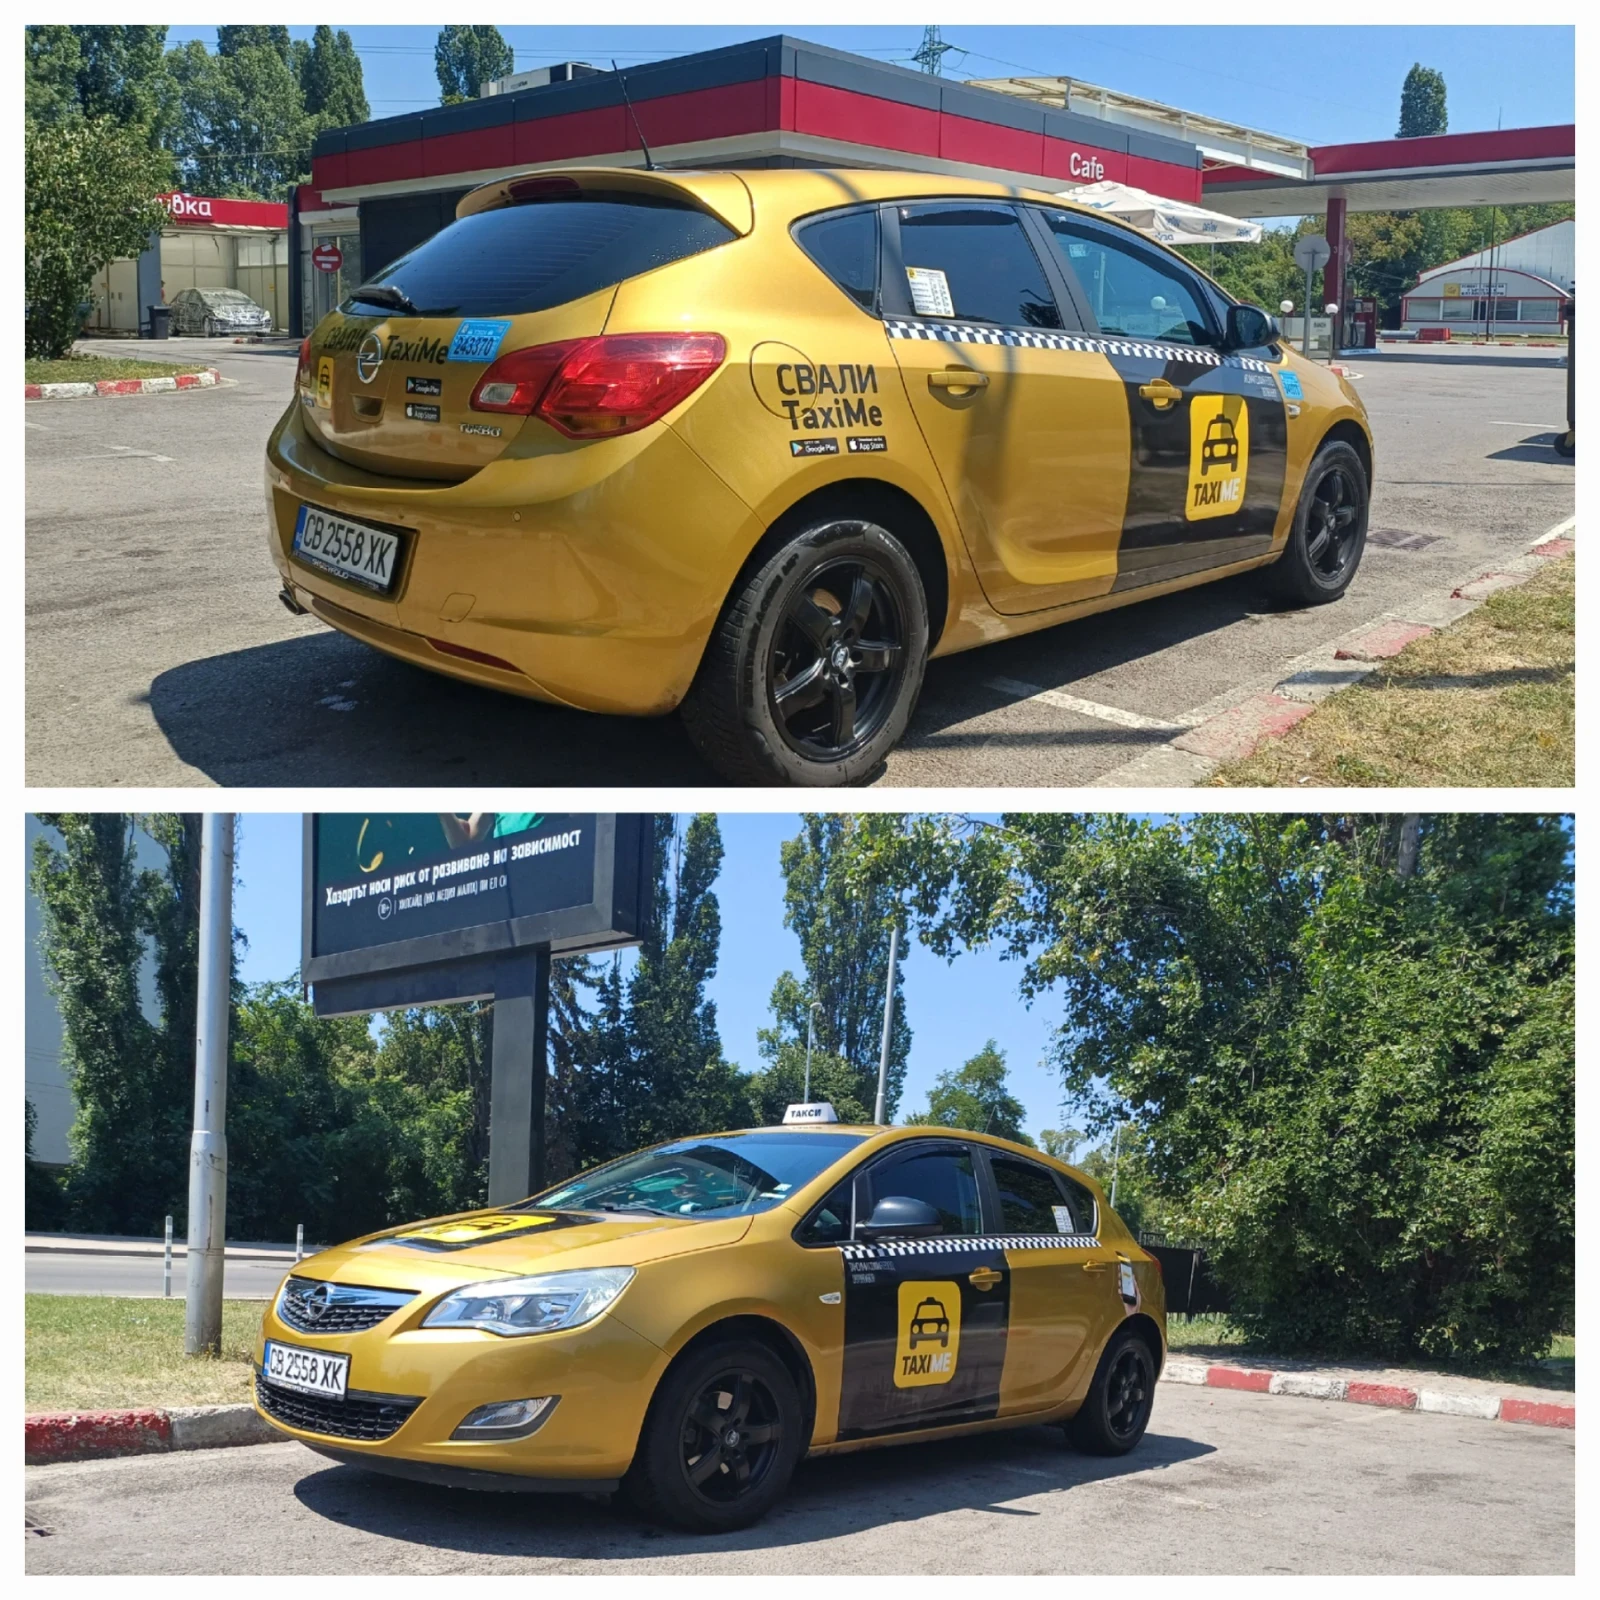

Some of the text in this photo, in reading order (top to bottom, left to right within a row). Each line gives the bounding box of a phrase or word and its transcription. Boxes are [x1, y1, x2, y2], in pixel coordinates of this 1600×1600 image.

[1070, 152, 1104, 180] Cafe
[384, 335, 449, 365] TaxiMe
[776, 364, 878, 396] СВАЛИ
[781, 398, 883, 430] TaxiMe
[805, 442, 825, 453] Google
[825, 440, 837, 452] Play
[859, 441, 885, 451] App Store
[1194, 477, 1241, 507] TAXIME
[322, 522, 364, 566] 2558
[326, 829, 581, 907] Хазартът носи риск от развиване на зависимост
[791, 1108, 822, 1117] ТАКСИ
[285, 1352, 318, 1384] 2558
[903, 1352, 952, 1376] TAXIME
